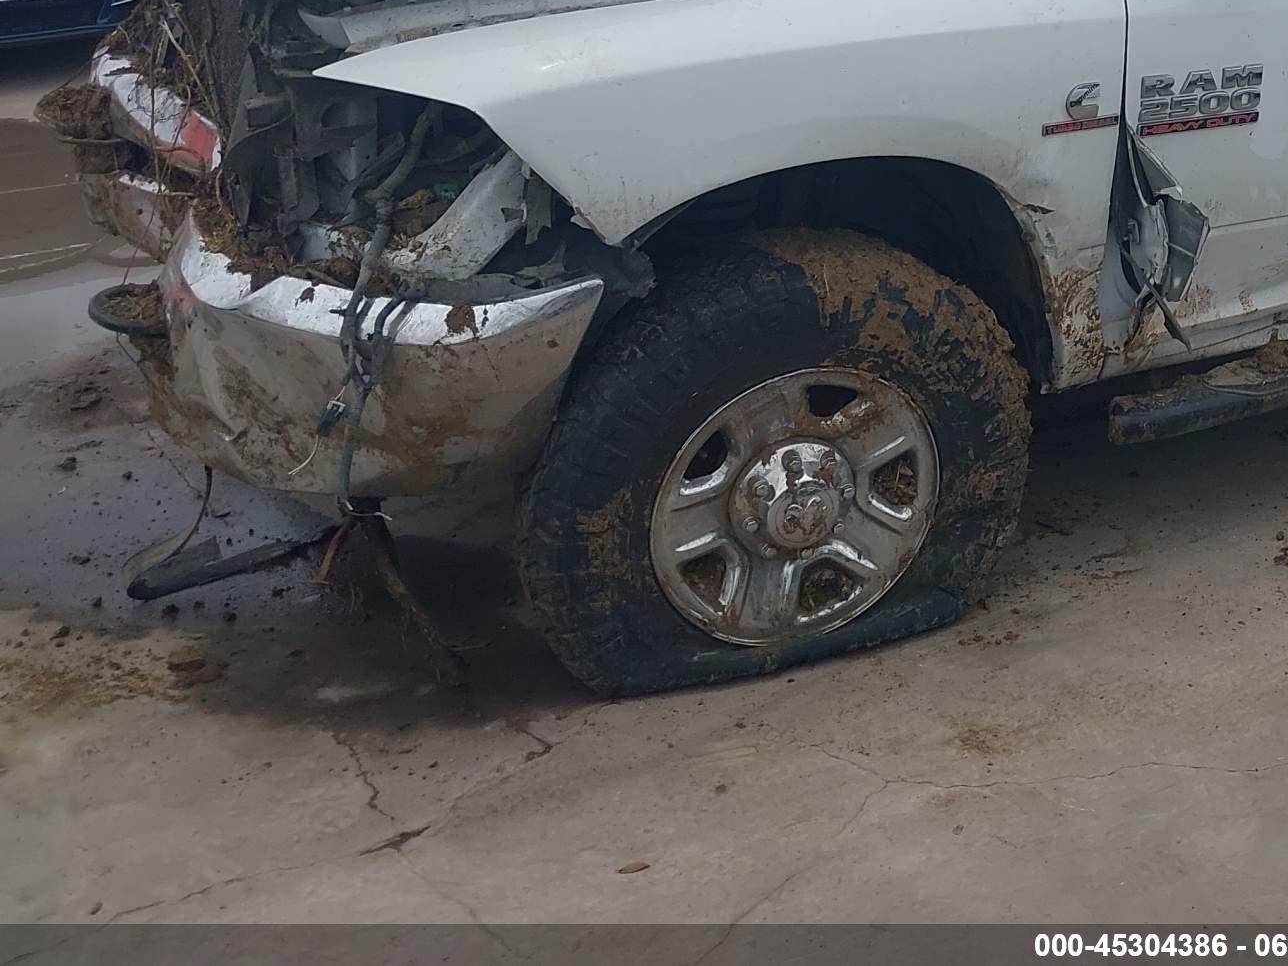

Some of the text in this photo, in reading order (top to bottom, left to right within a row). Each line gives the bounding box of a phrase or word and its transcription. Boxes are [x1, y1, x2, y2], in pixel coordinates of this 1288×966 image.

[1140, 64, 1263, 99] RAM
[1138, 87, 1261, 122] 2500
[1142, 114, 1256, 135] HEAVY DUTY
